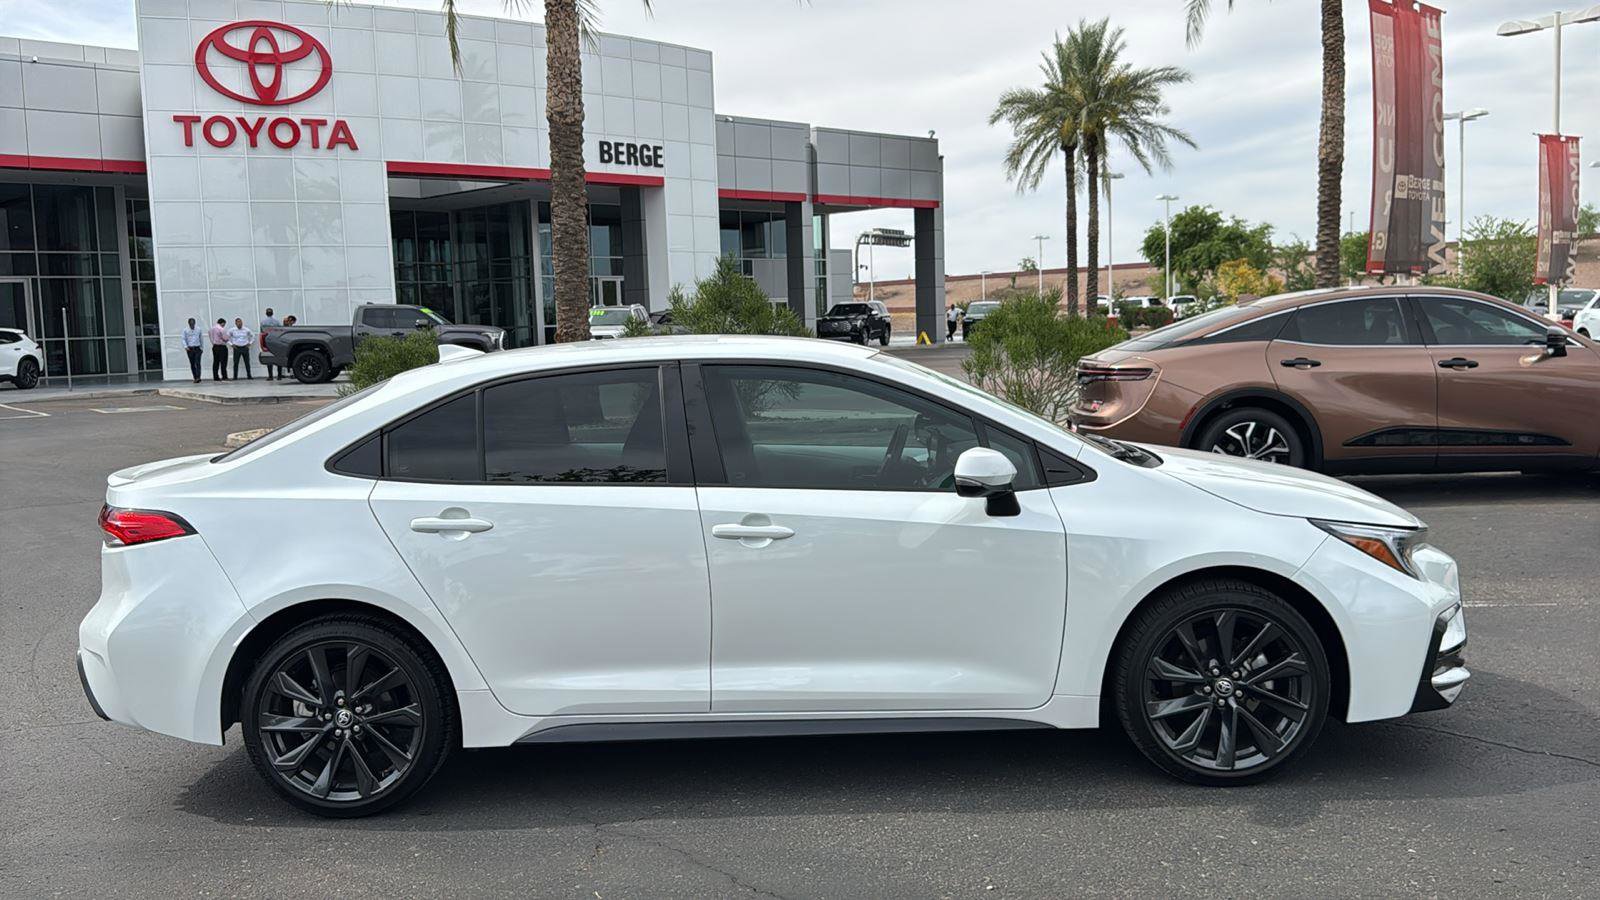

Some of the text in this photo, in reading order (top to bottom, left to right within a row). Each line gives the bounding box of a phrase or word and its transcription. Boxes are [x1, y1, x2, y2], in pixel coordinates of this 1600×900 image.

[172, 115, 359, 151] TOYOTA
[1425, 14, 1446, 273] WELCOME
[599, 140, 664, 168] BERGE
[1409, 174, 1430, 190] BERGE
